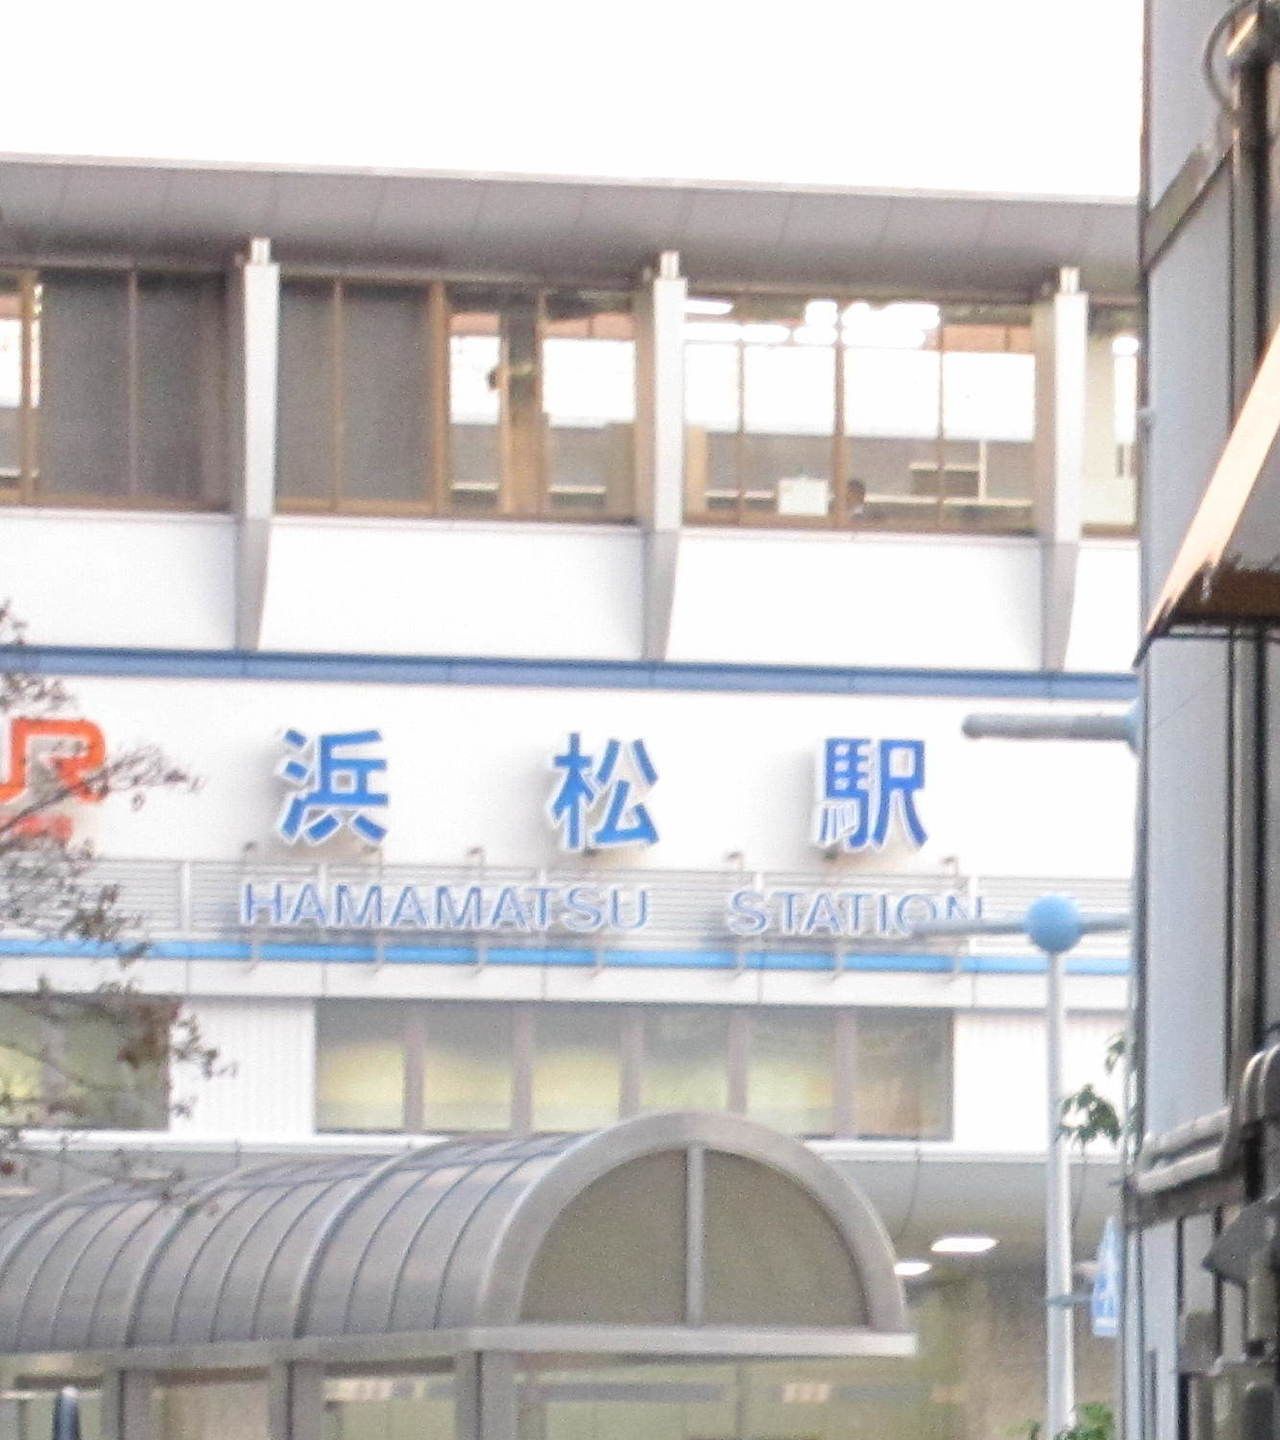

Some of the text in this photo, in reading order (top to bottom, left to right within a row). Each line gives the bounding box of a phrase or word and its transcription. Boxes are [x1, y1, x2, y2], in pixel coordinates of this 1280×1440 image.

[276, 728, 928, 850] 浜松駅
[239, 882, 984, 934] HAMAMATSU STATION
